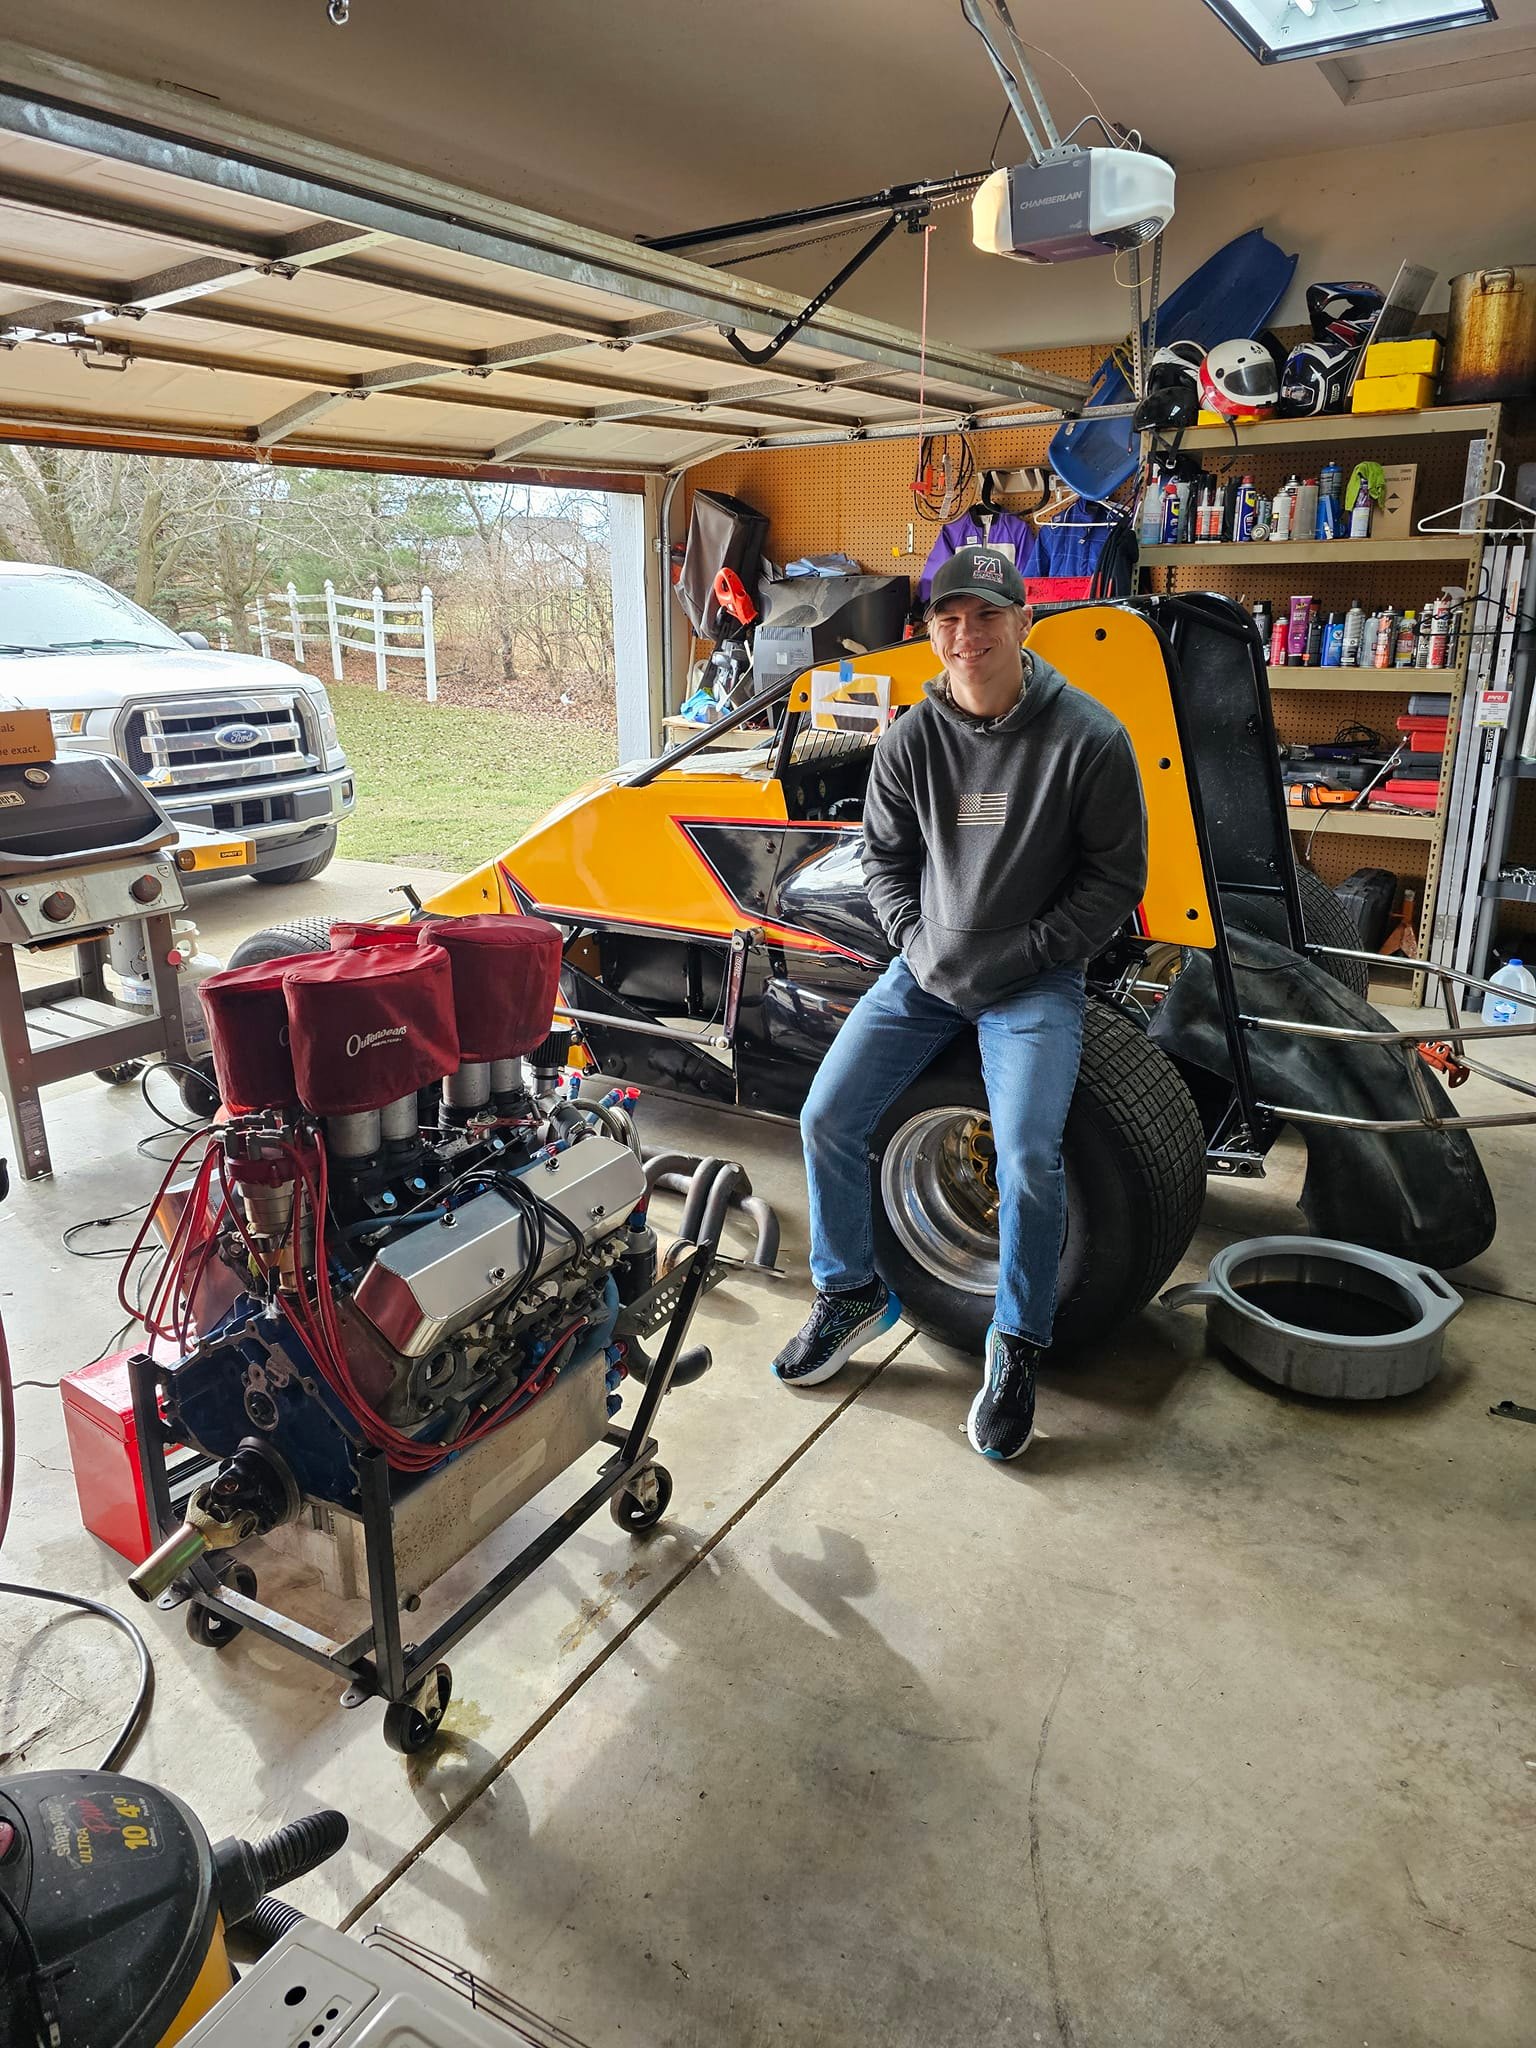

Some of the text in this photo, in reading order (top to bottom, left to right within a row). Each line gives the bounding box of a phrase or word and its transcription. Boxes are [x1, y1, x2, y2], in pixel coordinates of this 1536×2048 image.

[1019, 190, 1084, 210] CHAMBERLAIN
[973, 555, 1002, 574] 71
[230, 730, 254, 743] Ford
[11, 744, 40, 755] exact.
[346, 1025, 407, 1057] Outerwears
[77, 1827, 93, 1864] ULTRA
[122, 1825, 149, 1850] 10
